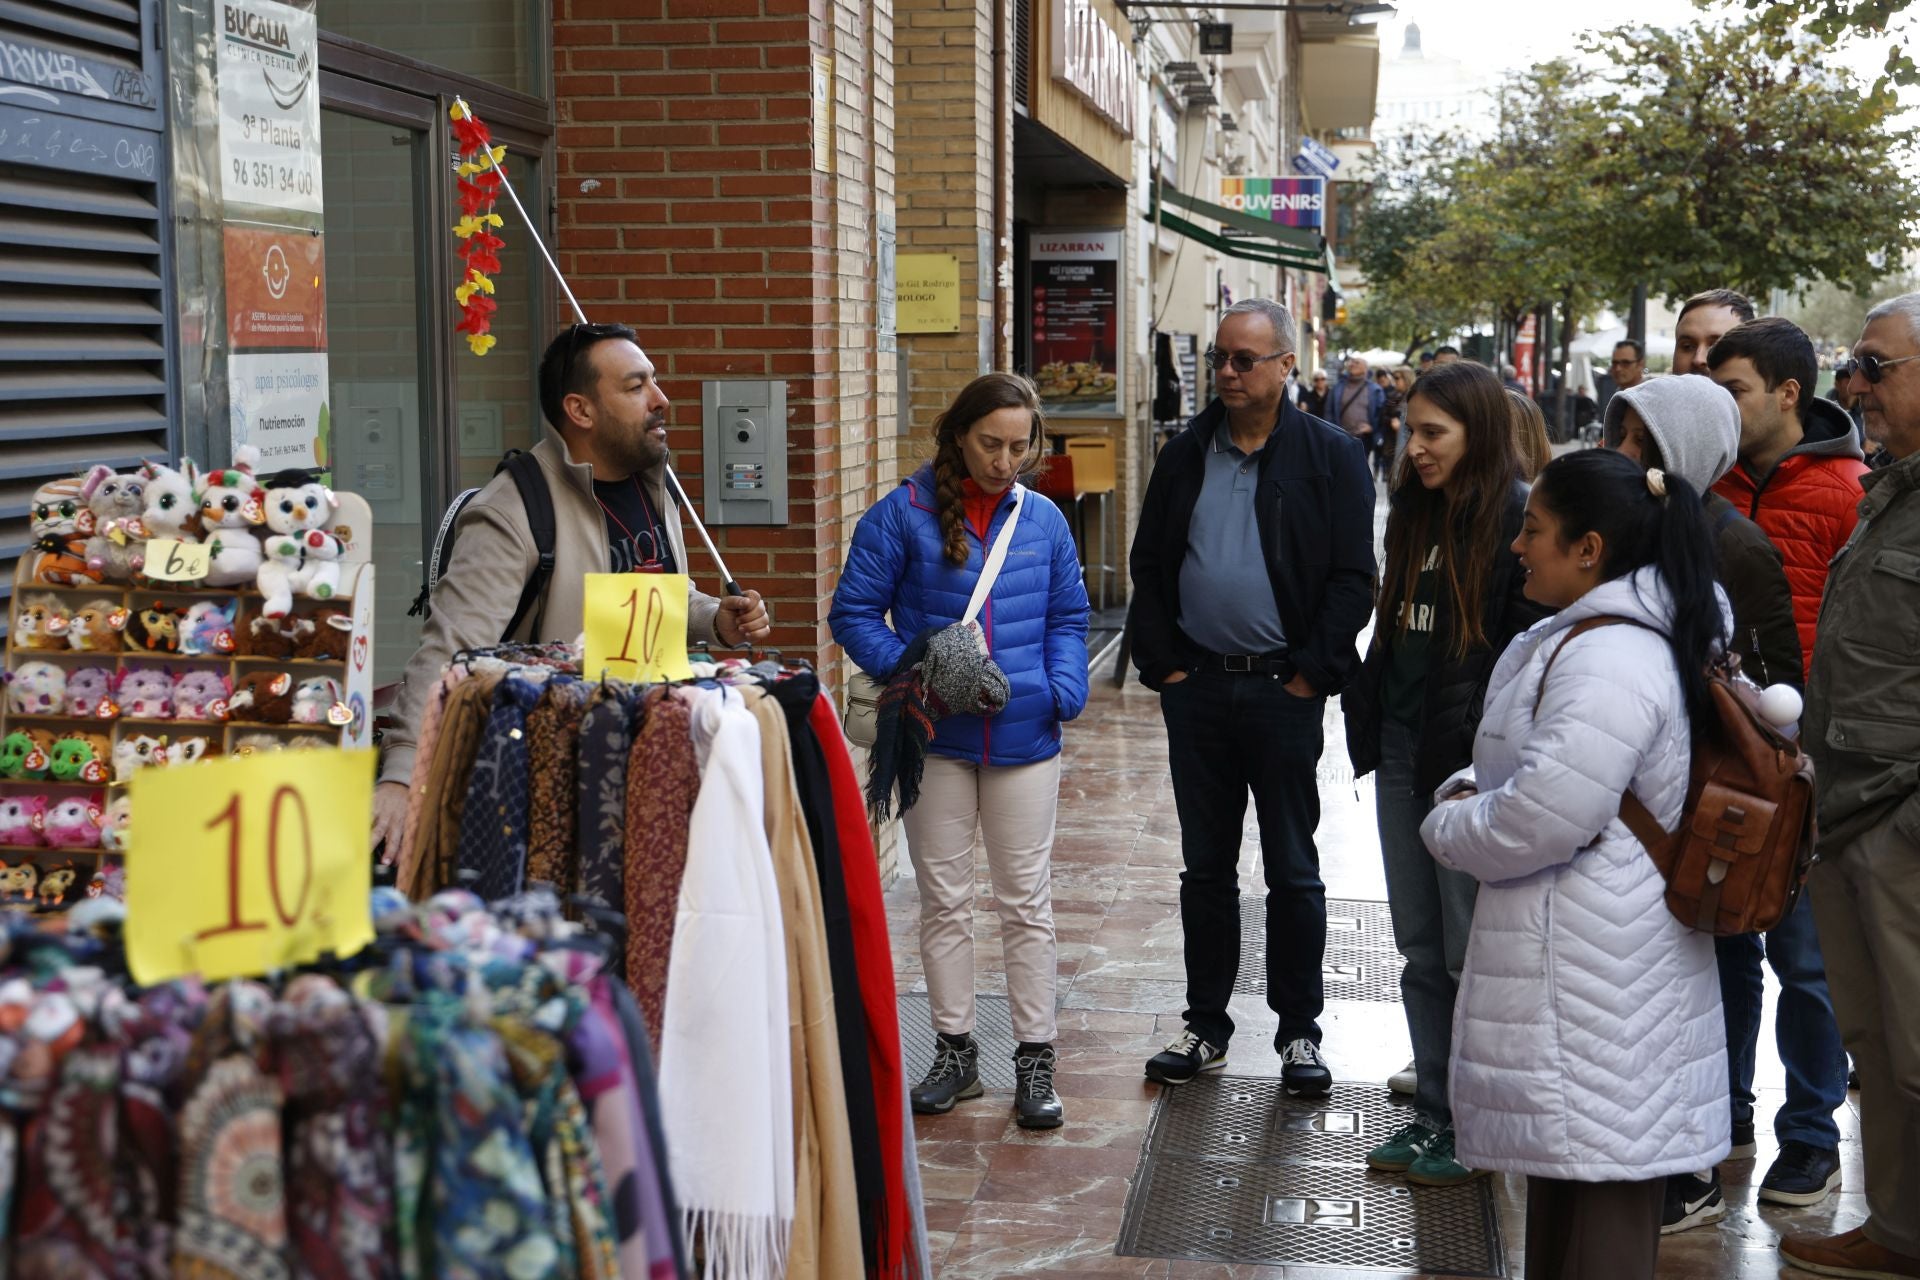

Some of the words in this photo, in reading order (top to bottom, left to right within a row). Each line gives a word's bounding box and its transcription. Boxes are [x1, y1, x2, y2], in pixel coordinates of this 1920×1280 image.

[224, 4, 291, 50] BUCALIA
[265, 54, 296, 73] DENTAL
[242, 113, 256, 140] 3ª
[260, 117, 301, 151] Planta
[233, 158, 249, 186] 96
[252, 161, 274, 190] 351
[279, 166, 295, 193] 34
[298, 169, 313, 196] 00
[1221, 193, 1321, 211] SOUVENIRS
[1040, 242, 1104, 253] LIZARRAN
[923, 280, 955, 289] Rodrigo
[276, 368, 319, 393] psicólogos
